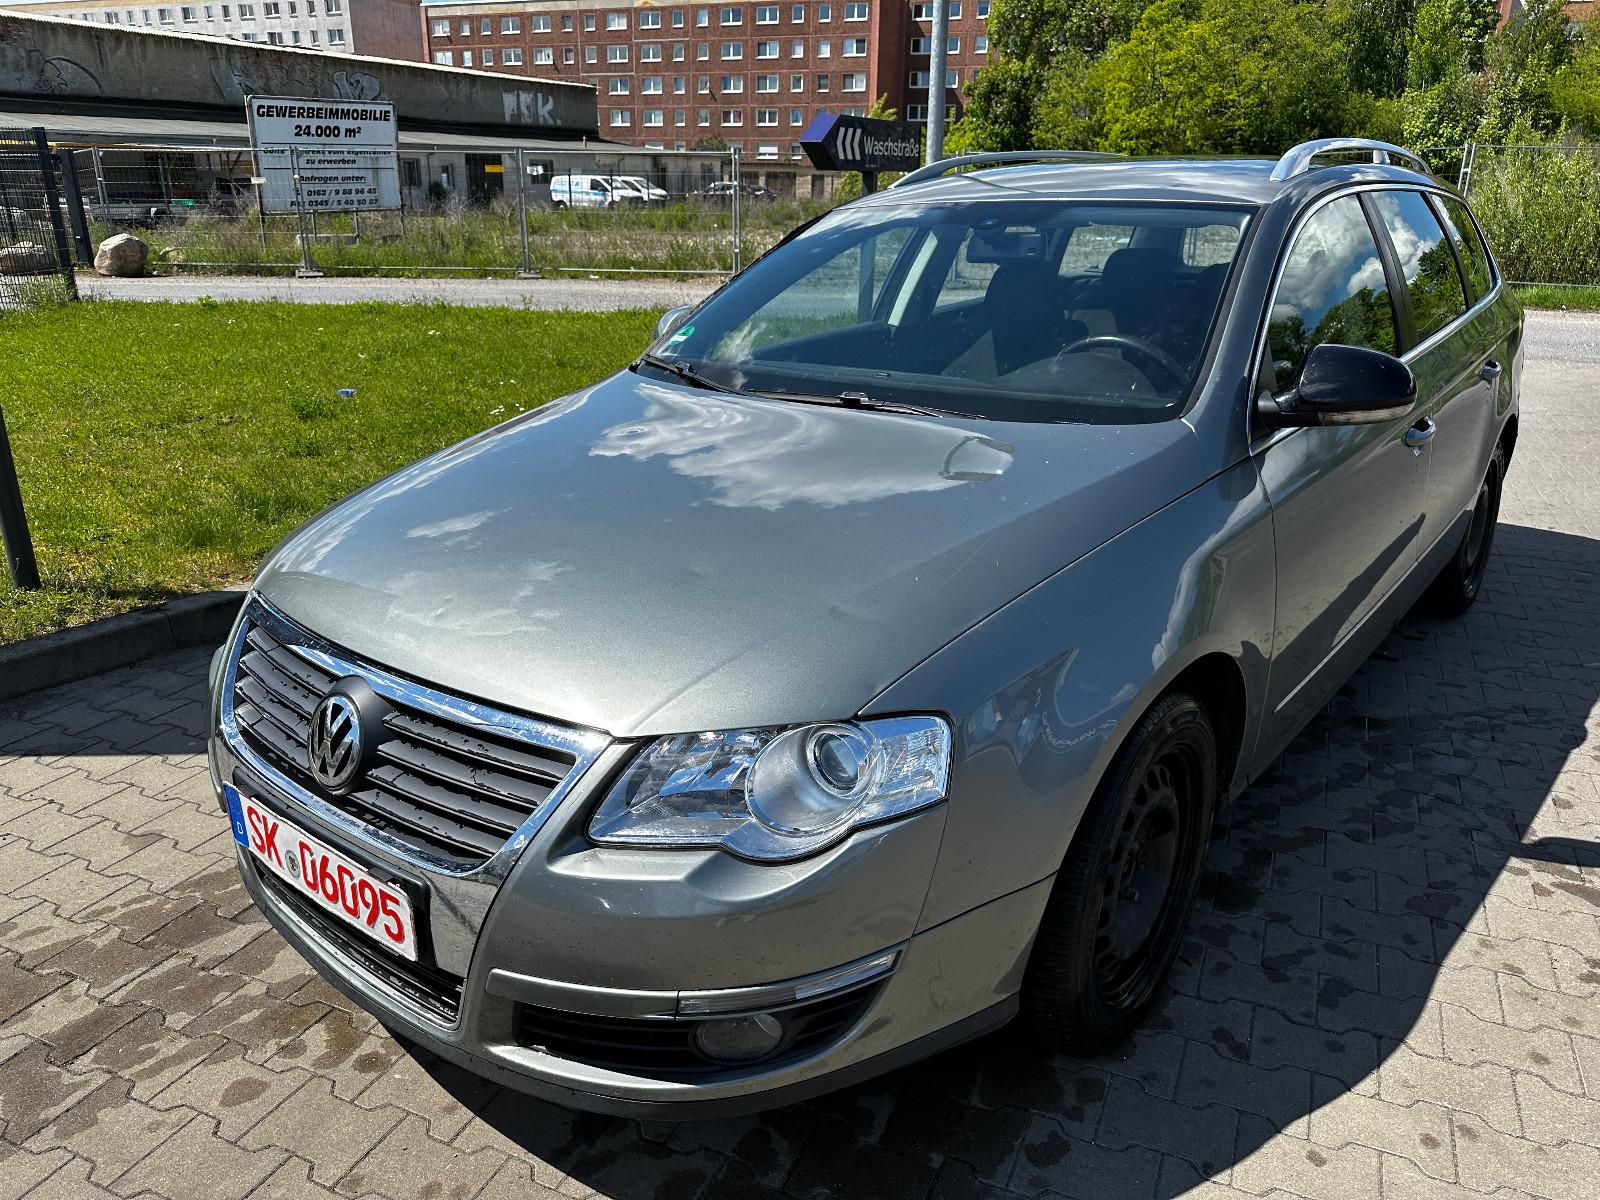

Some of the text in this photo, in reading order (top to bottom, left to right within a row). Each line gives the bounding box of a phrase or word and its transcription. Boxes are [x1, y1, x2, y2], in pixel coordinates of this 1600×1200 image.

[256, 104, 391, 122] GEWERBEIMMOBILIE
[294, 124, 340, 138] 24.000
[863, 136, 919, 158] Waschstraße
[247, 805, 406, 944] SK 06095
